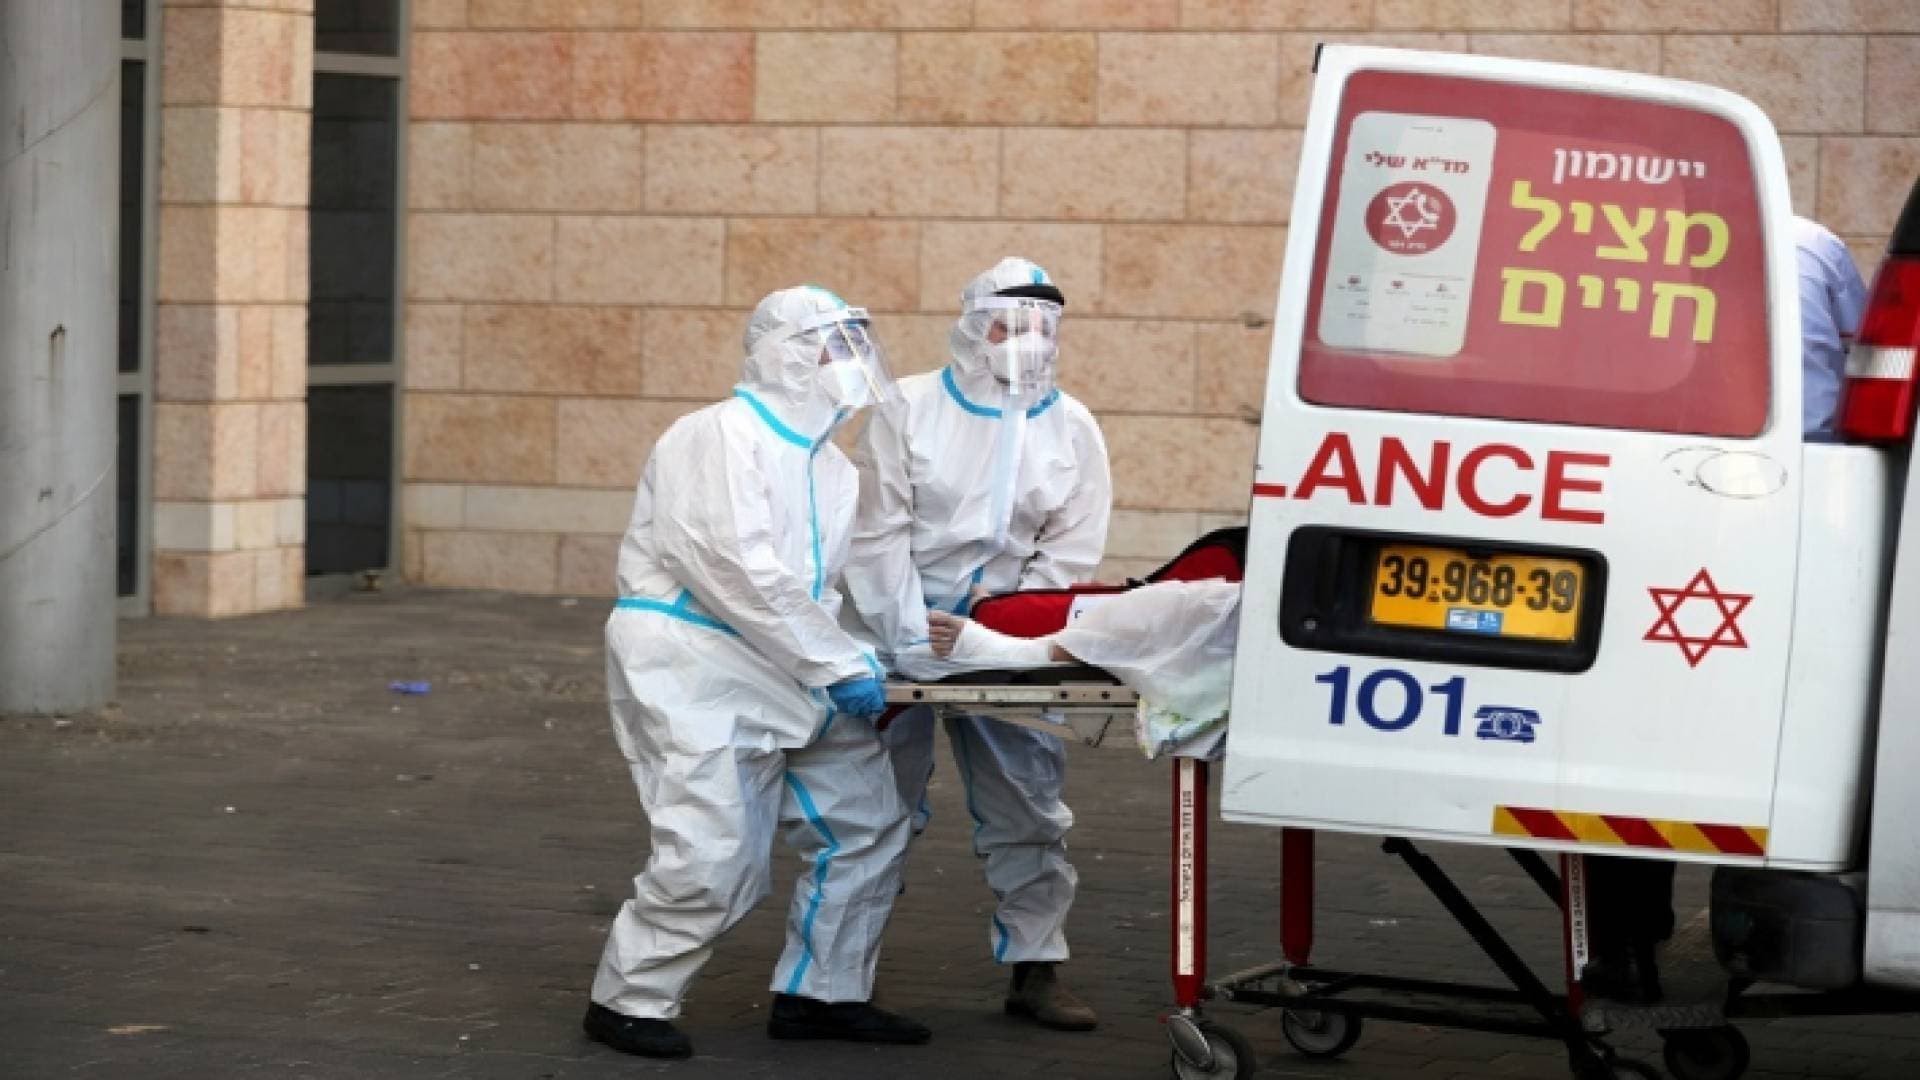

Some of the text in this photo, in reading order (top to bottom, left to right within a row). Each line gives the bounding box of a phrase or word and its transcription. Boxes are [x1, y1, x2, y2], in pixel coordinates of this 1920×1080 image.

[1551, 148, 1706, 185] יישומון
[1510, 180, 1729, 268] מציל
[1499, 266, 1717, 344] חיים
[1315, 663, 1466, 736] 101
